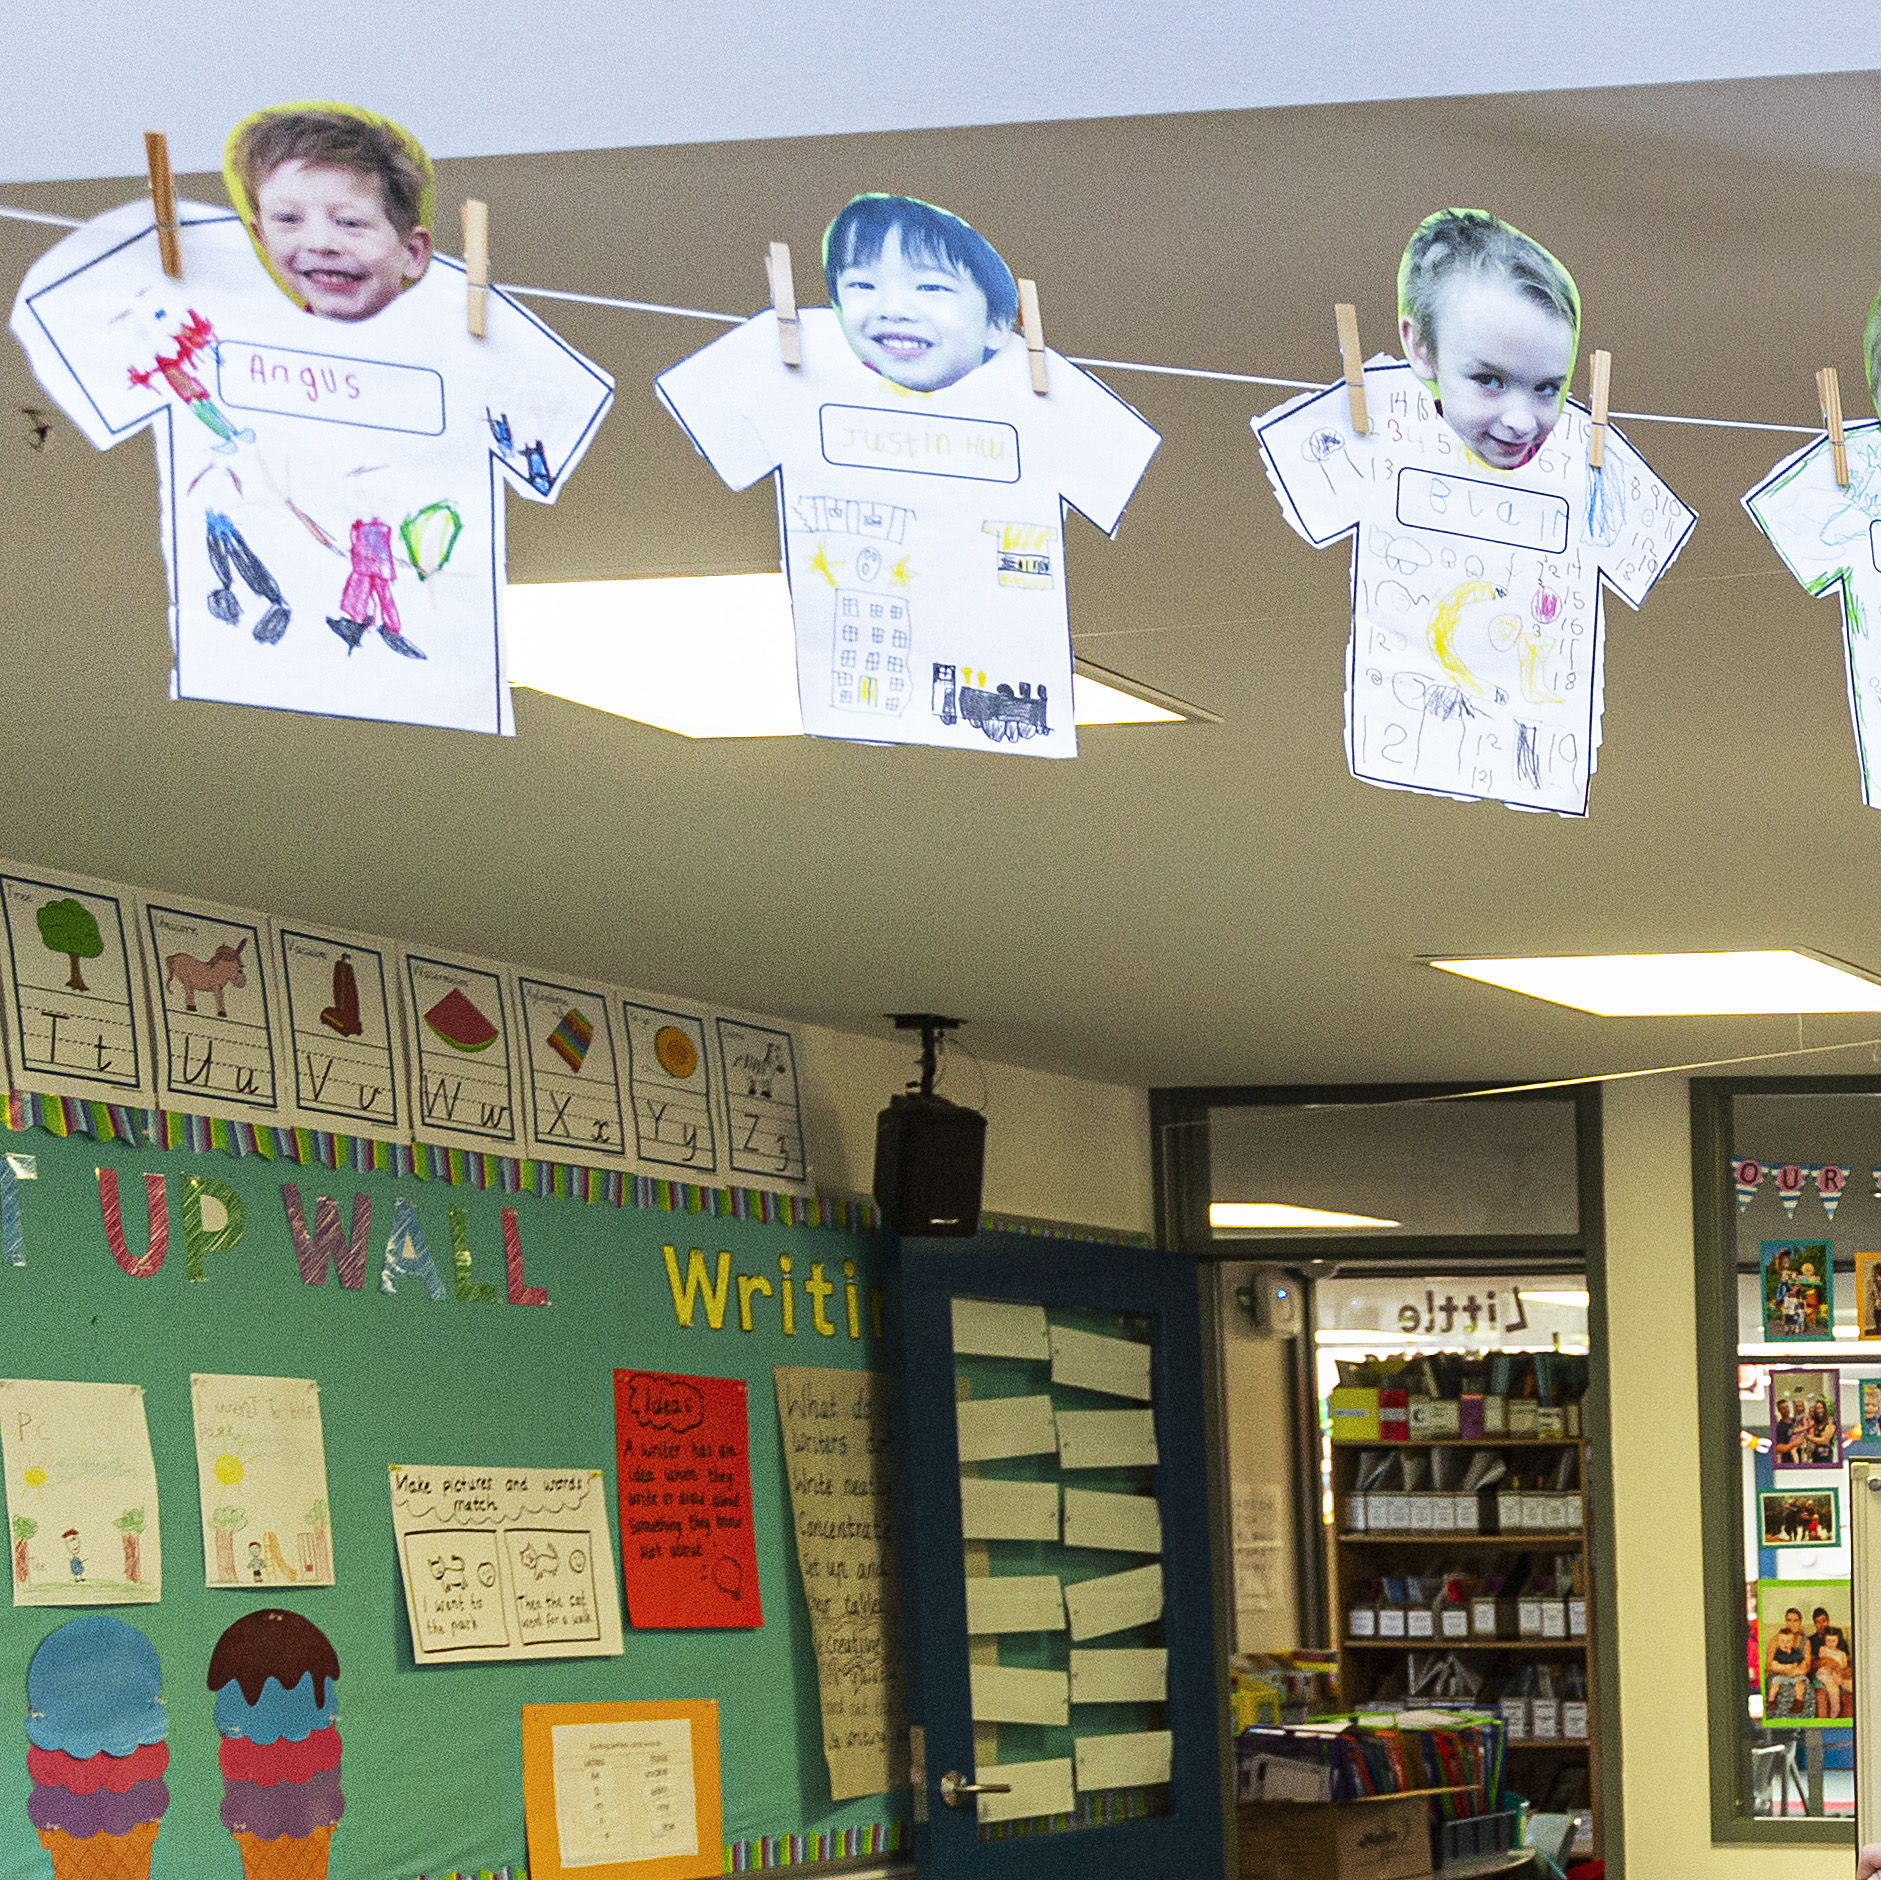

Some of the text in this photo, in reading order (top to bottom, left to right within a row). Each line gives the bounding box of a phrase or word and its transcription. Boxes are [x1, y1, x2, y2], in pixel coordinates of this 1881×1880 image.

[251, 353, 361, 402] Angus
[42, 1012, 69, 1063] T
[184, 1035, 213, 1088] U
[307, 1054, 332, 1100] V
[425, 1074, 461, 1120] W
[547, 1092, 571, 1137] X
[648, 1100, 667, 1140] Y
[745, 1114, 759, 1151] Z
[1740, 1161, 1840, 1192] OUR
[96, 1168, 549, 1306] UP WALL
[395, 1474, 582, 1496] Make pictures and words
[454, 1498, 498, 1512] match
